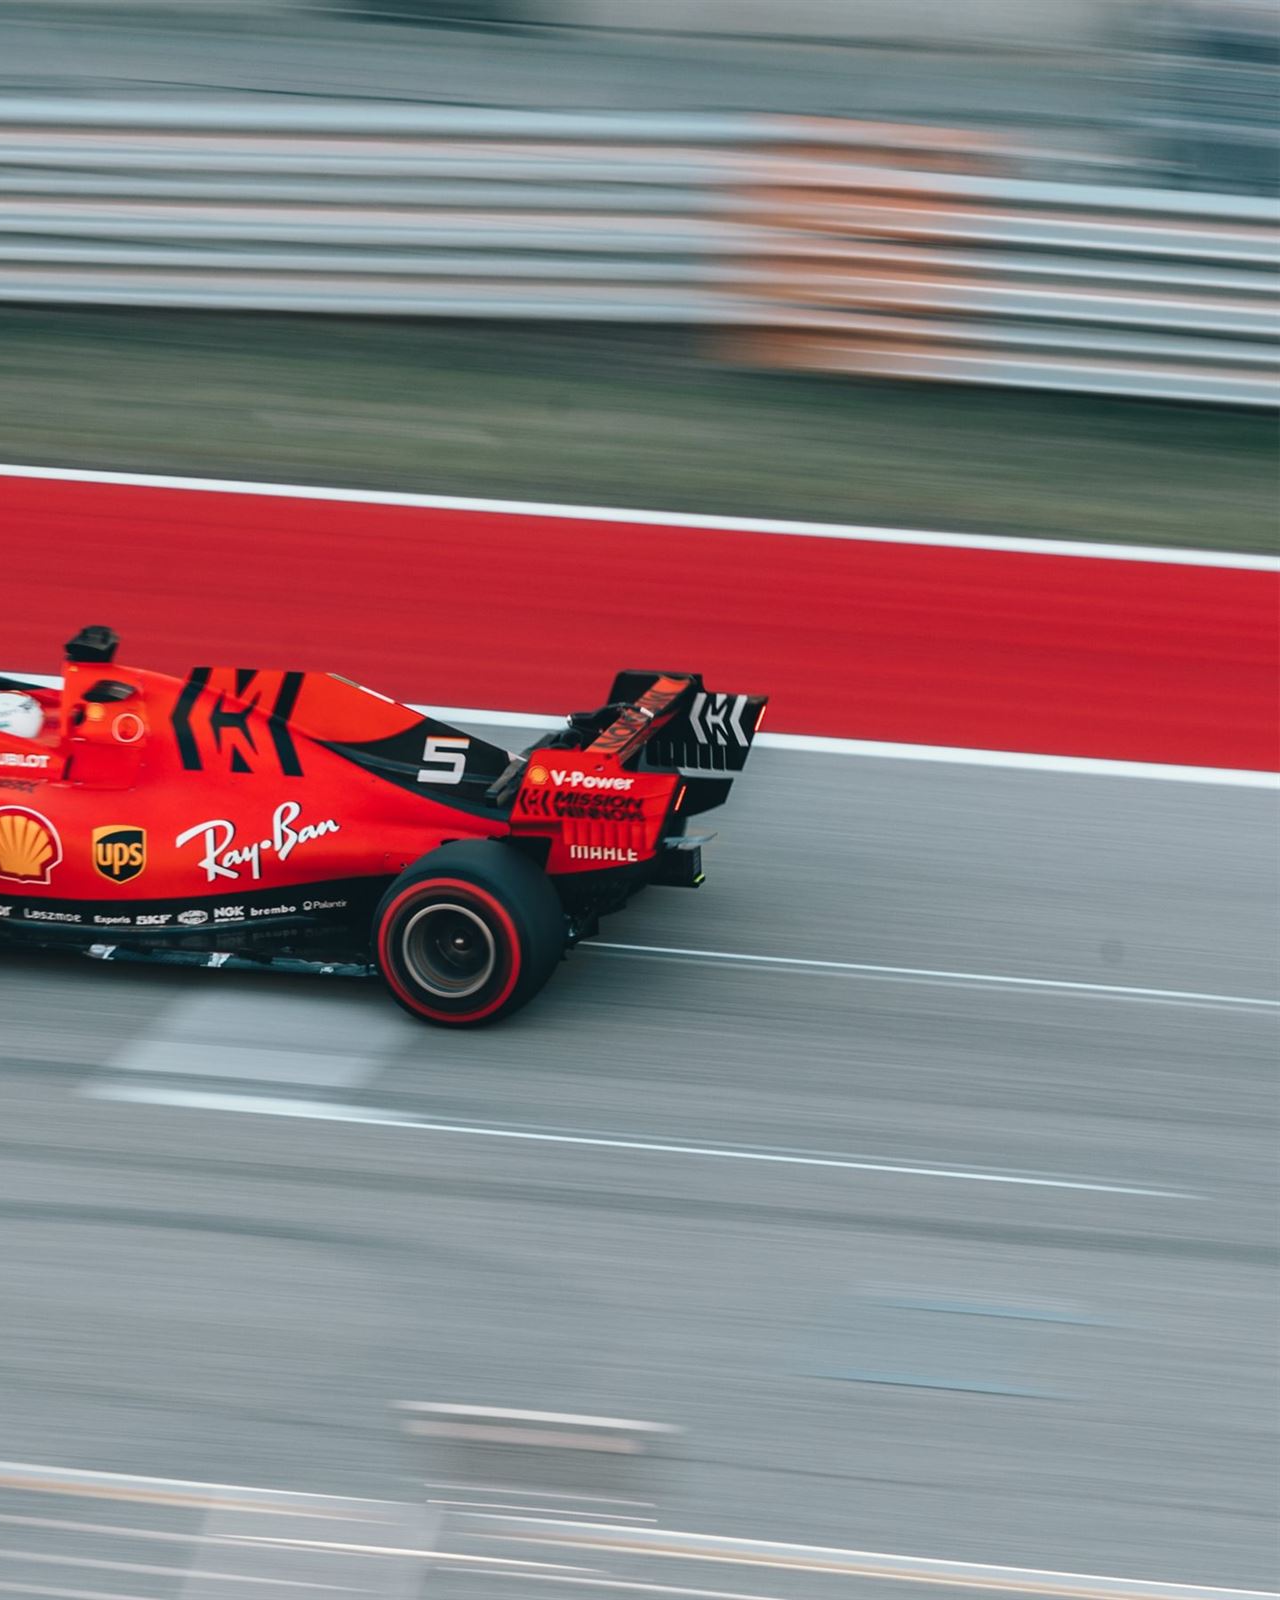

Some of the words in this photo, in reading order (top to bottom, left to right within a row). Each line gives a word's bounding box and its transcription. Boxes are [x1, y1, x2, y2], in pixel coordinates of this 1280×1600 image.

[417, 736, 470, 784] 5
[550, 769, 634, 790] V-Power
[570, 845, 638, 862] MAHLE
[213, 906, 245, 919] NGK
[250, 905, 297, 917] brembo
[135, 913, 172, 926] SKF
